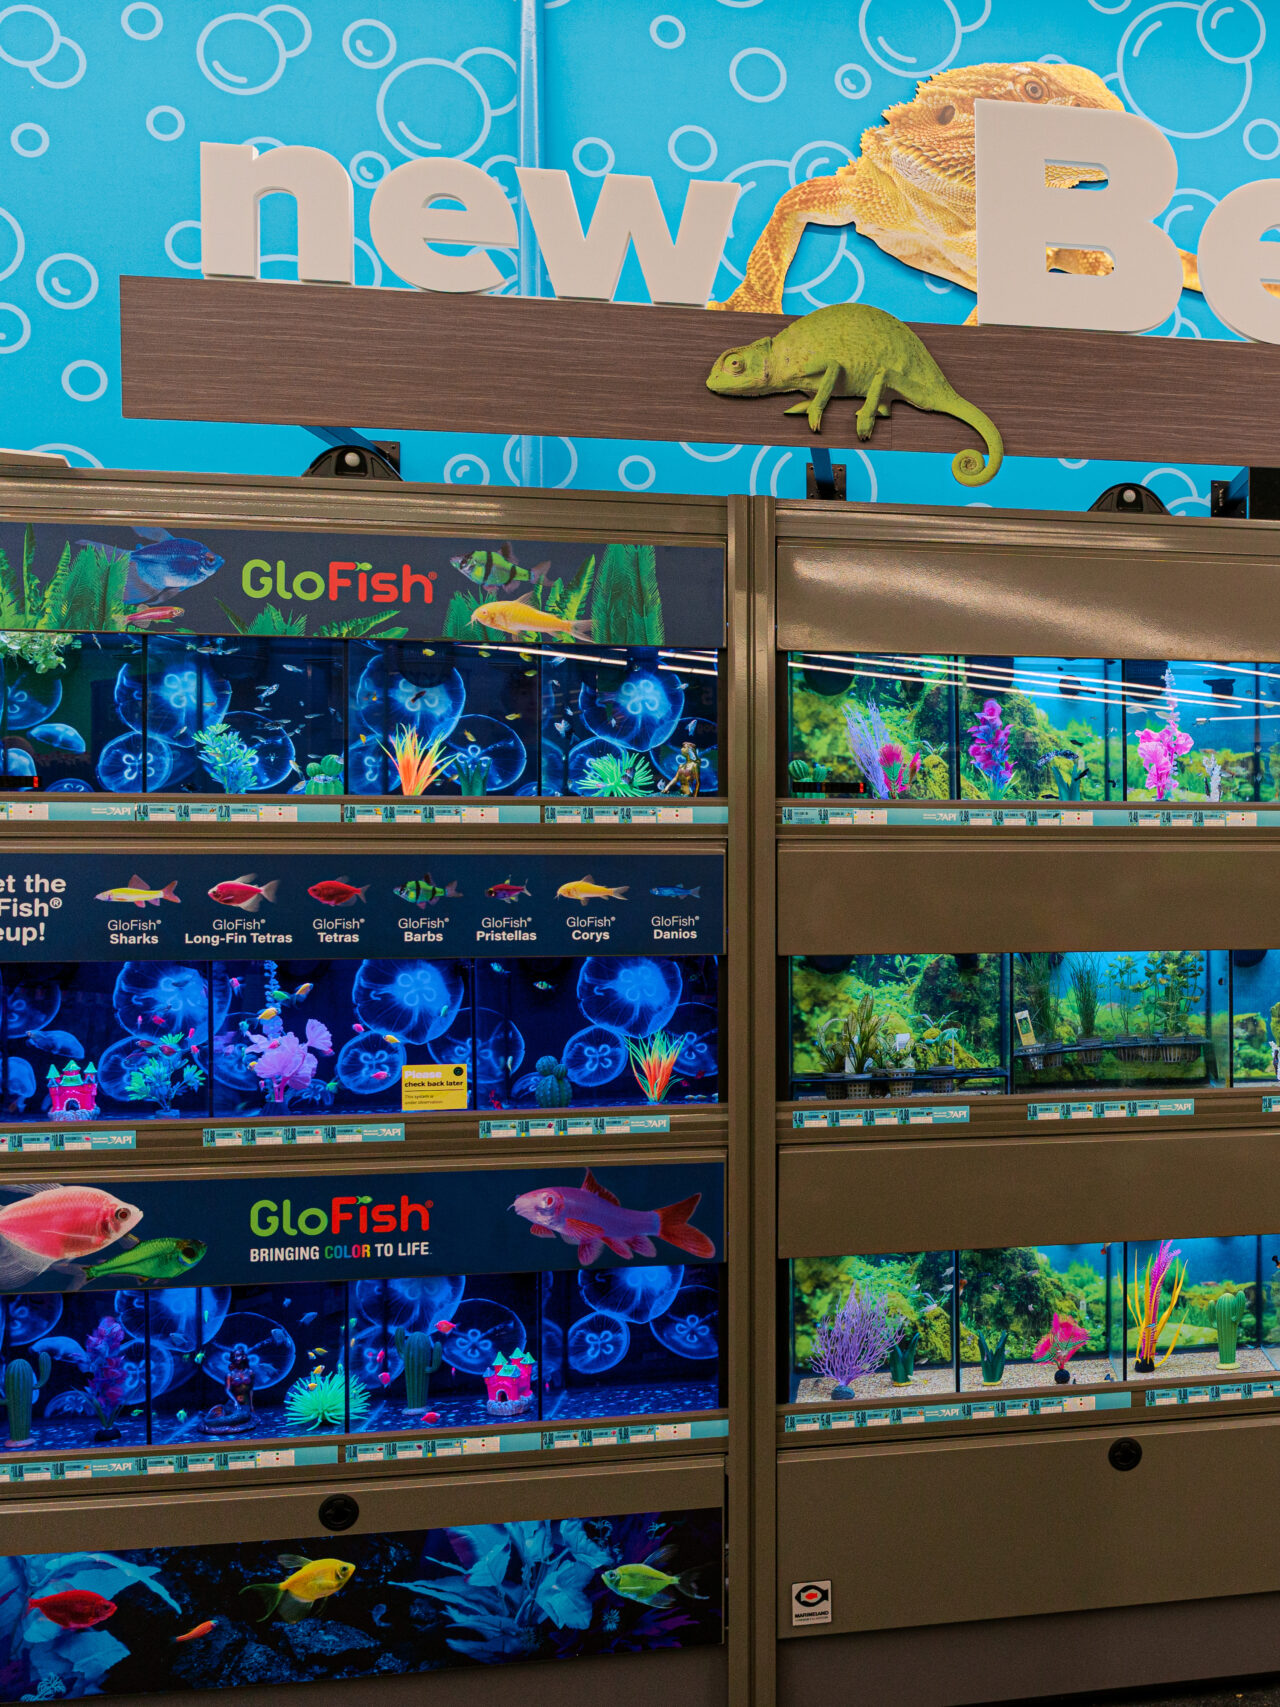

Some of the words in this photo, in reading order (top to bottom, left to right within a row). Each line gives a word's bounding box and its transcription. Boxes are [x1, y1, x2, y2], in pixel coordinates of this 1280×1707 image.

[200, 142, 741, 309] new
[114, 807, 131, 815] API
[24, 873, 66, 892] the
[0, 922, 45, 946] up!
[110, 933, 159, 945] Sharks
[185, 933, 247, 946] Long-Fin
[250, 932, 293, 944] Tetras
[317, 932, 360, 943] Tetras
[404, 931, 443, 942] Barbs
[476, 930, 537, 942] Pristellas
[571, 929, 610, 942] Corys
[653, 928, 697, 940] Danios
[404, 1070, 442, 1079] Please
[1177, 1103, 1192, 1111] API
[951, 1111, 967, 1119] API
[650, 1119, 667, 1127] API
[385, 1128, 401, 1136] API
[115, 1135, 132, 1144] API
[250, 1246, 320, 1262] BRINGING
[325, 1244, 371, 1259] COLOR
[375, 1243, 393, 1257] TO
[943, 1408, 960, 1416] API
[116, 1462, 133, 1472] API
